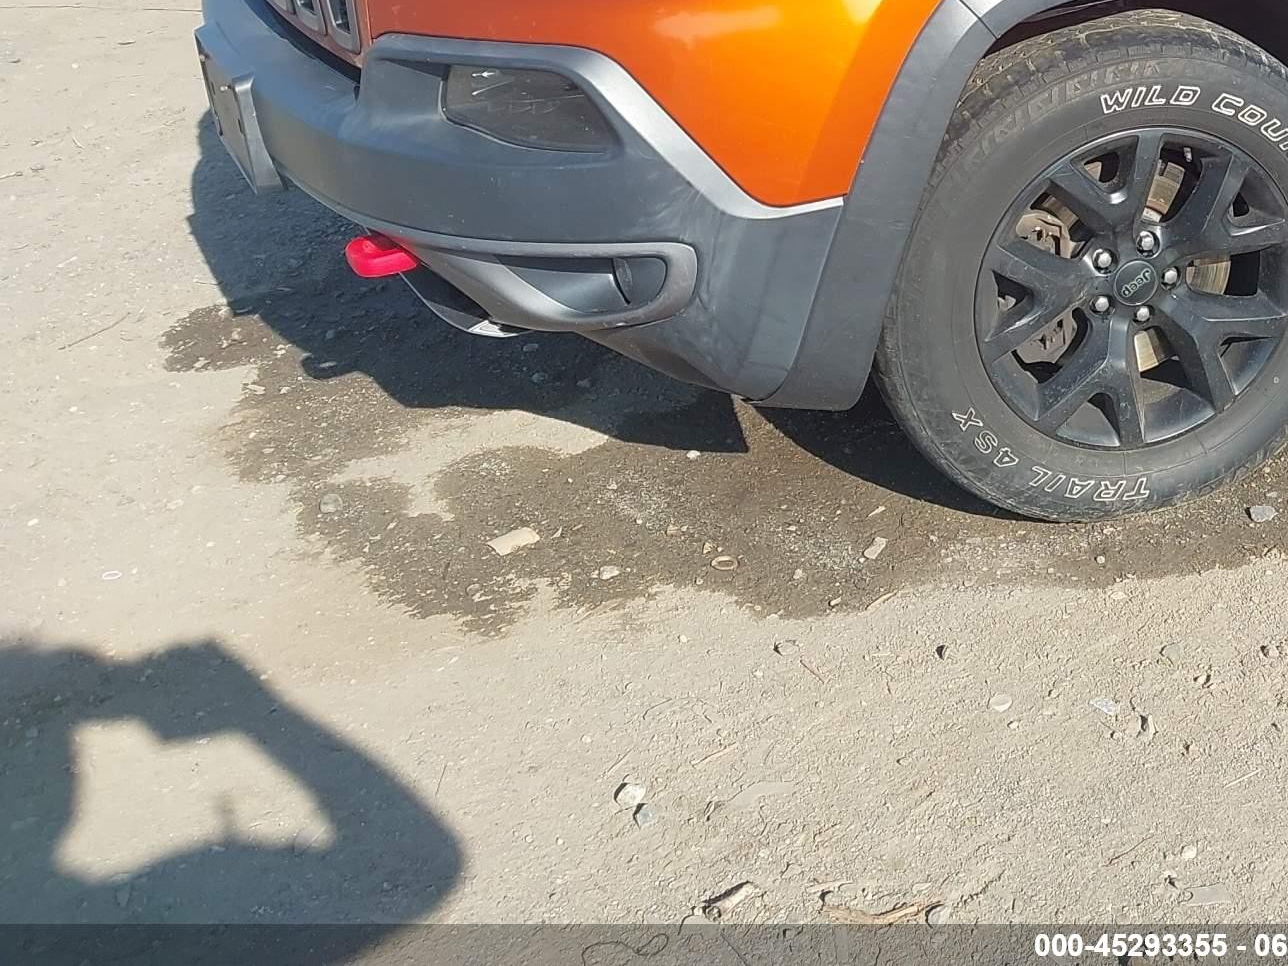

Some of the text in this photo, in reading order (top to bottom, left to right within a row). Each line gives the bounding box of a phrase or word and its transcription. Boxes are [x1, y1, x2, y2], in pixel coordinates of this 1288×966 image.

[1100, 85, 1201, 115] WILD
[1121, 268, 1152, 298] Jeep
[952, 407, 1150, 502] TRAIL 4SX
